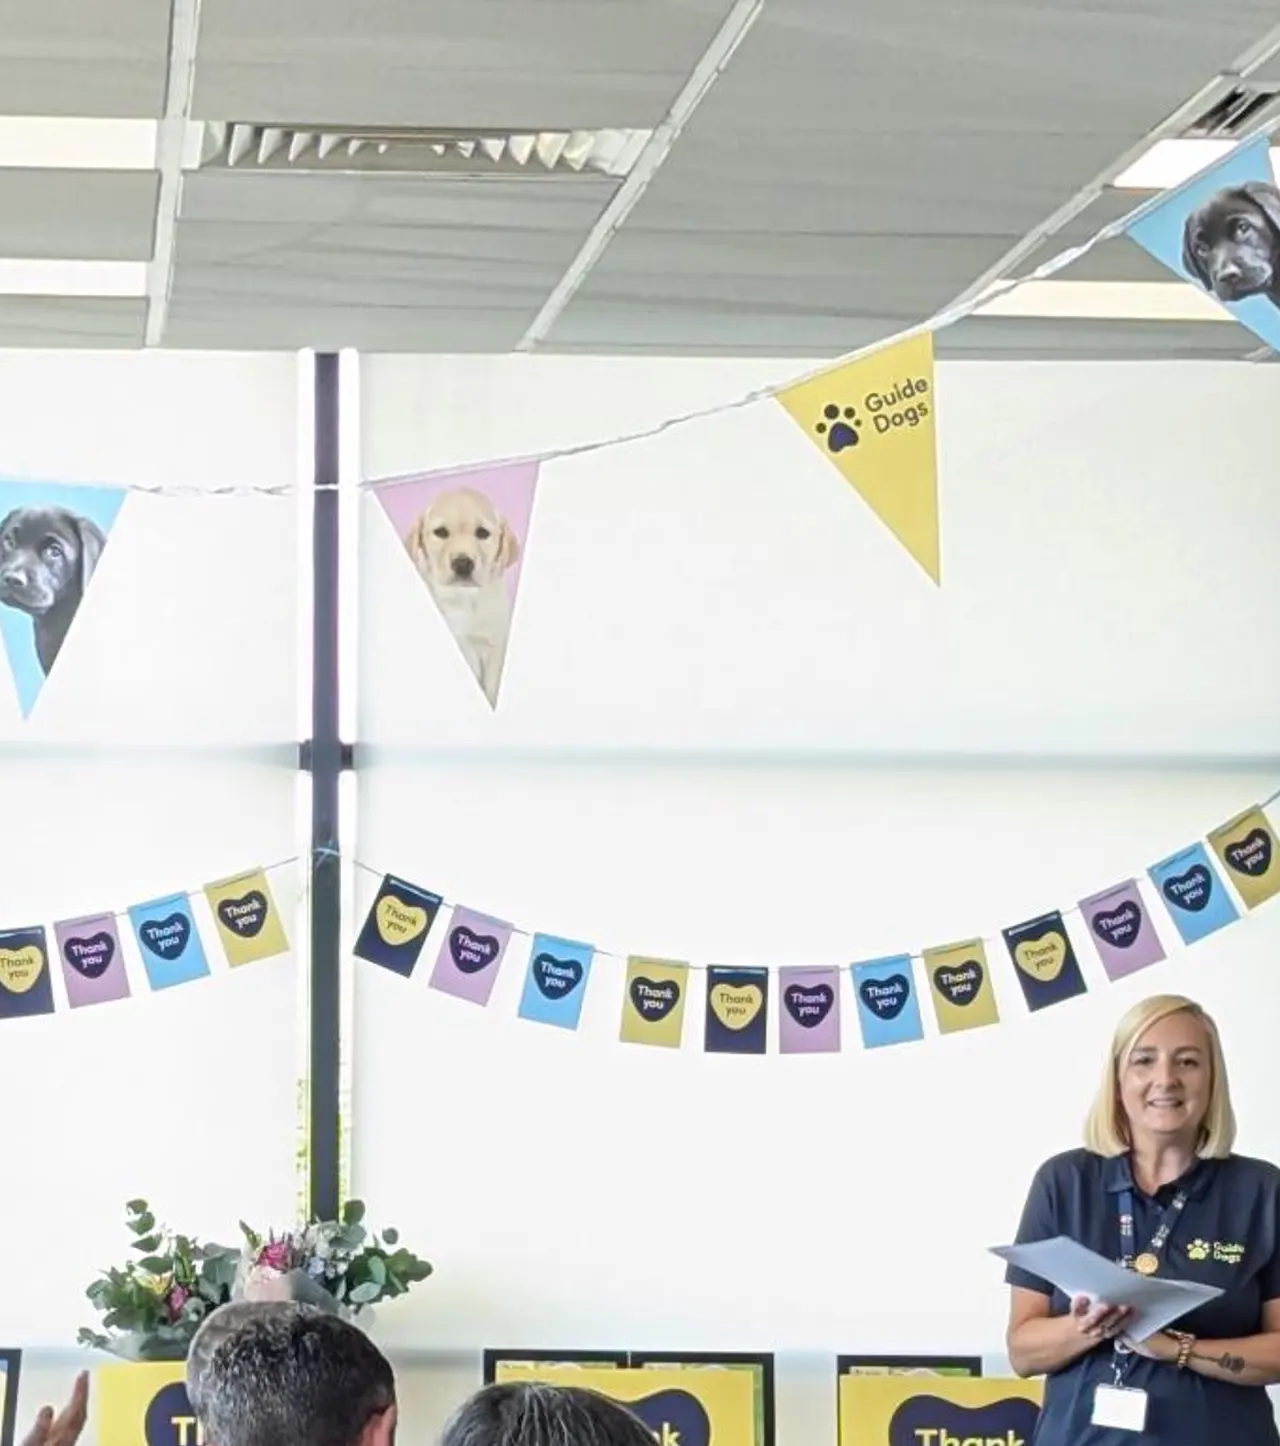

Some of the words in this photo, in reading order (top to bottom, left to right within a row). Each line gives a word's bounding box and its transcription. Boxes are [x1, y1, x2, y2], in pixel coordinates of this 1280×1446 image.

[864, 378, 928, 412] Guide
[872, 402, 929, 434] Dogs
[1230, 837, 1265, 861] Thank
[1244, 851, 1264, 870] you
[1170, 872, 1205, 895] Thank
[1183, 887, 1203, 904] you
[224, 899, 261, 918] Thank
[384, 904, 417, 926] Thank
[235, 914, 257, 929] you
[1099, 908, 1134, 929] Thank
[147, 921, 185, 940] Thank
[386, 920, 407, 934] you
[1110, 924, 1133, 941] you
[72, 940, 108, 956] Thank
[158, 936, 180, 952] you
[458, 934, 491, 955] Thank
[1024, 941, 1057, 960] Thank
[0, 955, 34, 968] Thank
[81, 956, 102, 969] you
[459, 950, 481, 963] you
[1035, 957, 1054, 971] you
[8, 970, 29, 981] you
[541, 961, 575, 979] Thank
[941, 969, 977, 985] Thank
[544, 976, 566, 988] you
[866, 982, 903, 997] Thank
[638, 984, 673, 999] Thank
[791, 993, 828, 1003] Thank
[950, 984, 972, 997] you
[642, 999, 664, 1010] you
[720, 993, 754, 1004] Thank
[876, 996, 898, 1010] you
[726, 1007, 746, 1017] you
[798, 1006, 820, 1017] you
[1213, 1242, 1245, 1253] Guide
[1213, 1250, 1241, 1264] Dogs
